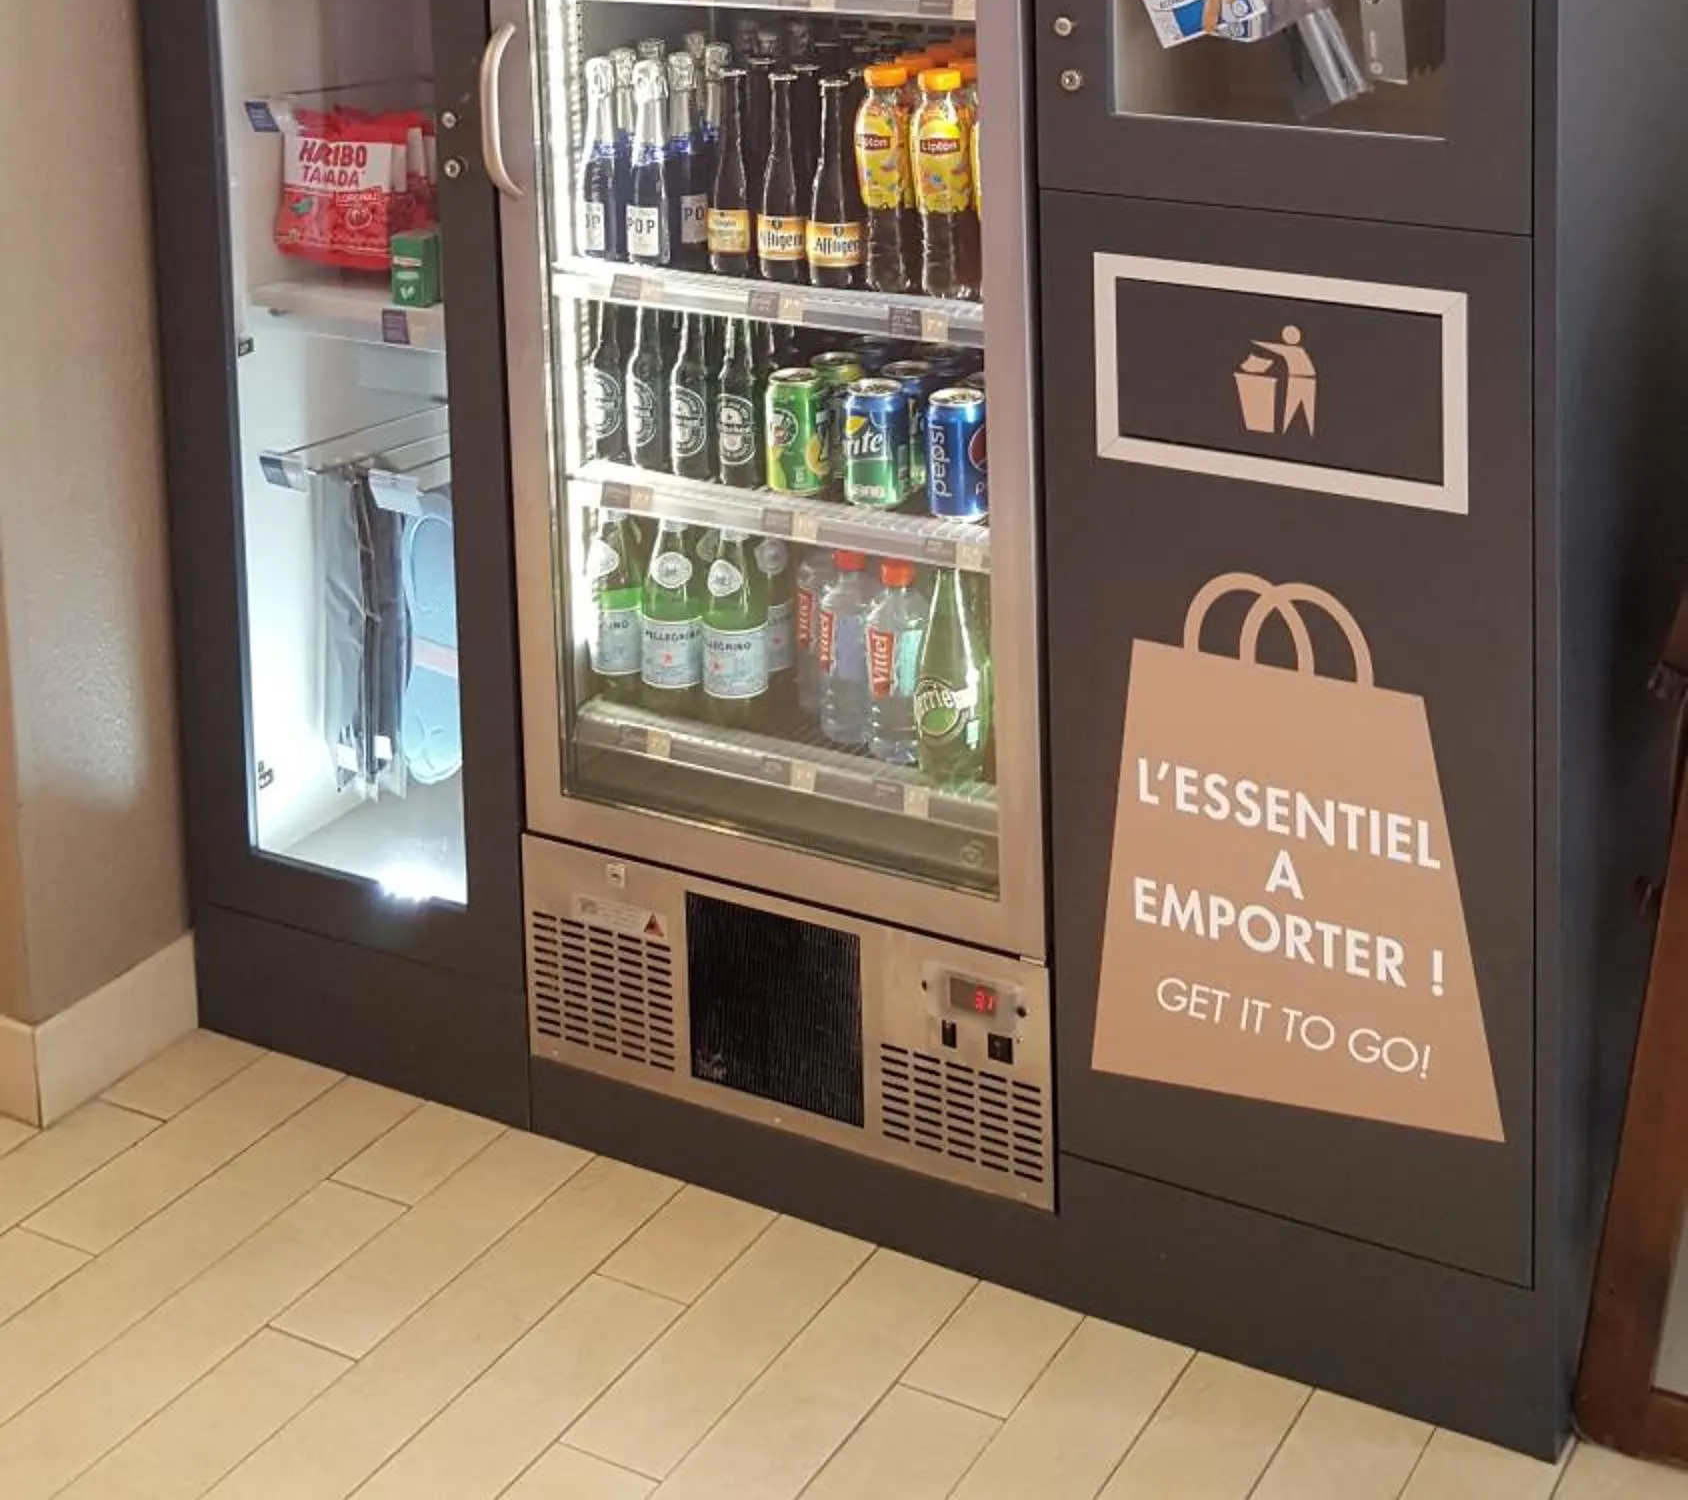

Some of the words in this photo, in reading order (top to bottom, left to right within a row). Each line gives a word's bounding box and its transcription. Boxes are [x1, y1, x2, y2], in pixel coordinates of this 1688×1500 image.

[299, 140, 368, 168] HARIBO
[921, 140, 959, 153] Lipton
[302, 165, 360, 187] TAADA
[930, 424, 952, 498] pepsi
[872, 634, 889, 684] Vittel
[1136, 756, 1442, 870] L'ESSENTIEL
[1264, 848, 1304, 901] A
[1133, 875, 1408, 989] EMPORTER
[1429, 948, 1446, 998] !
[1155, 976, 1230, 1024] GET
[1240, 996, 1272, 1035] IT
[1282, 1006, 1336, 1052] TO
[1347, 1027, 1432, 1079] GO!
